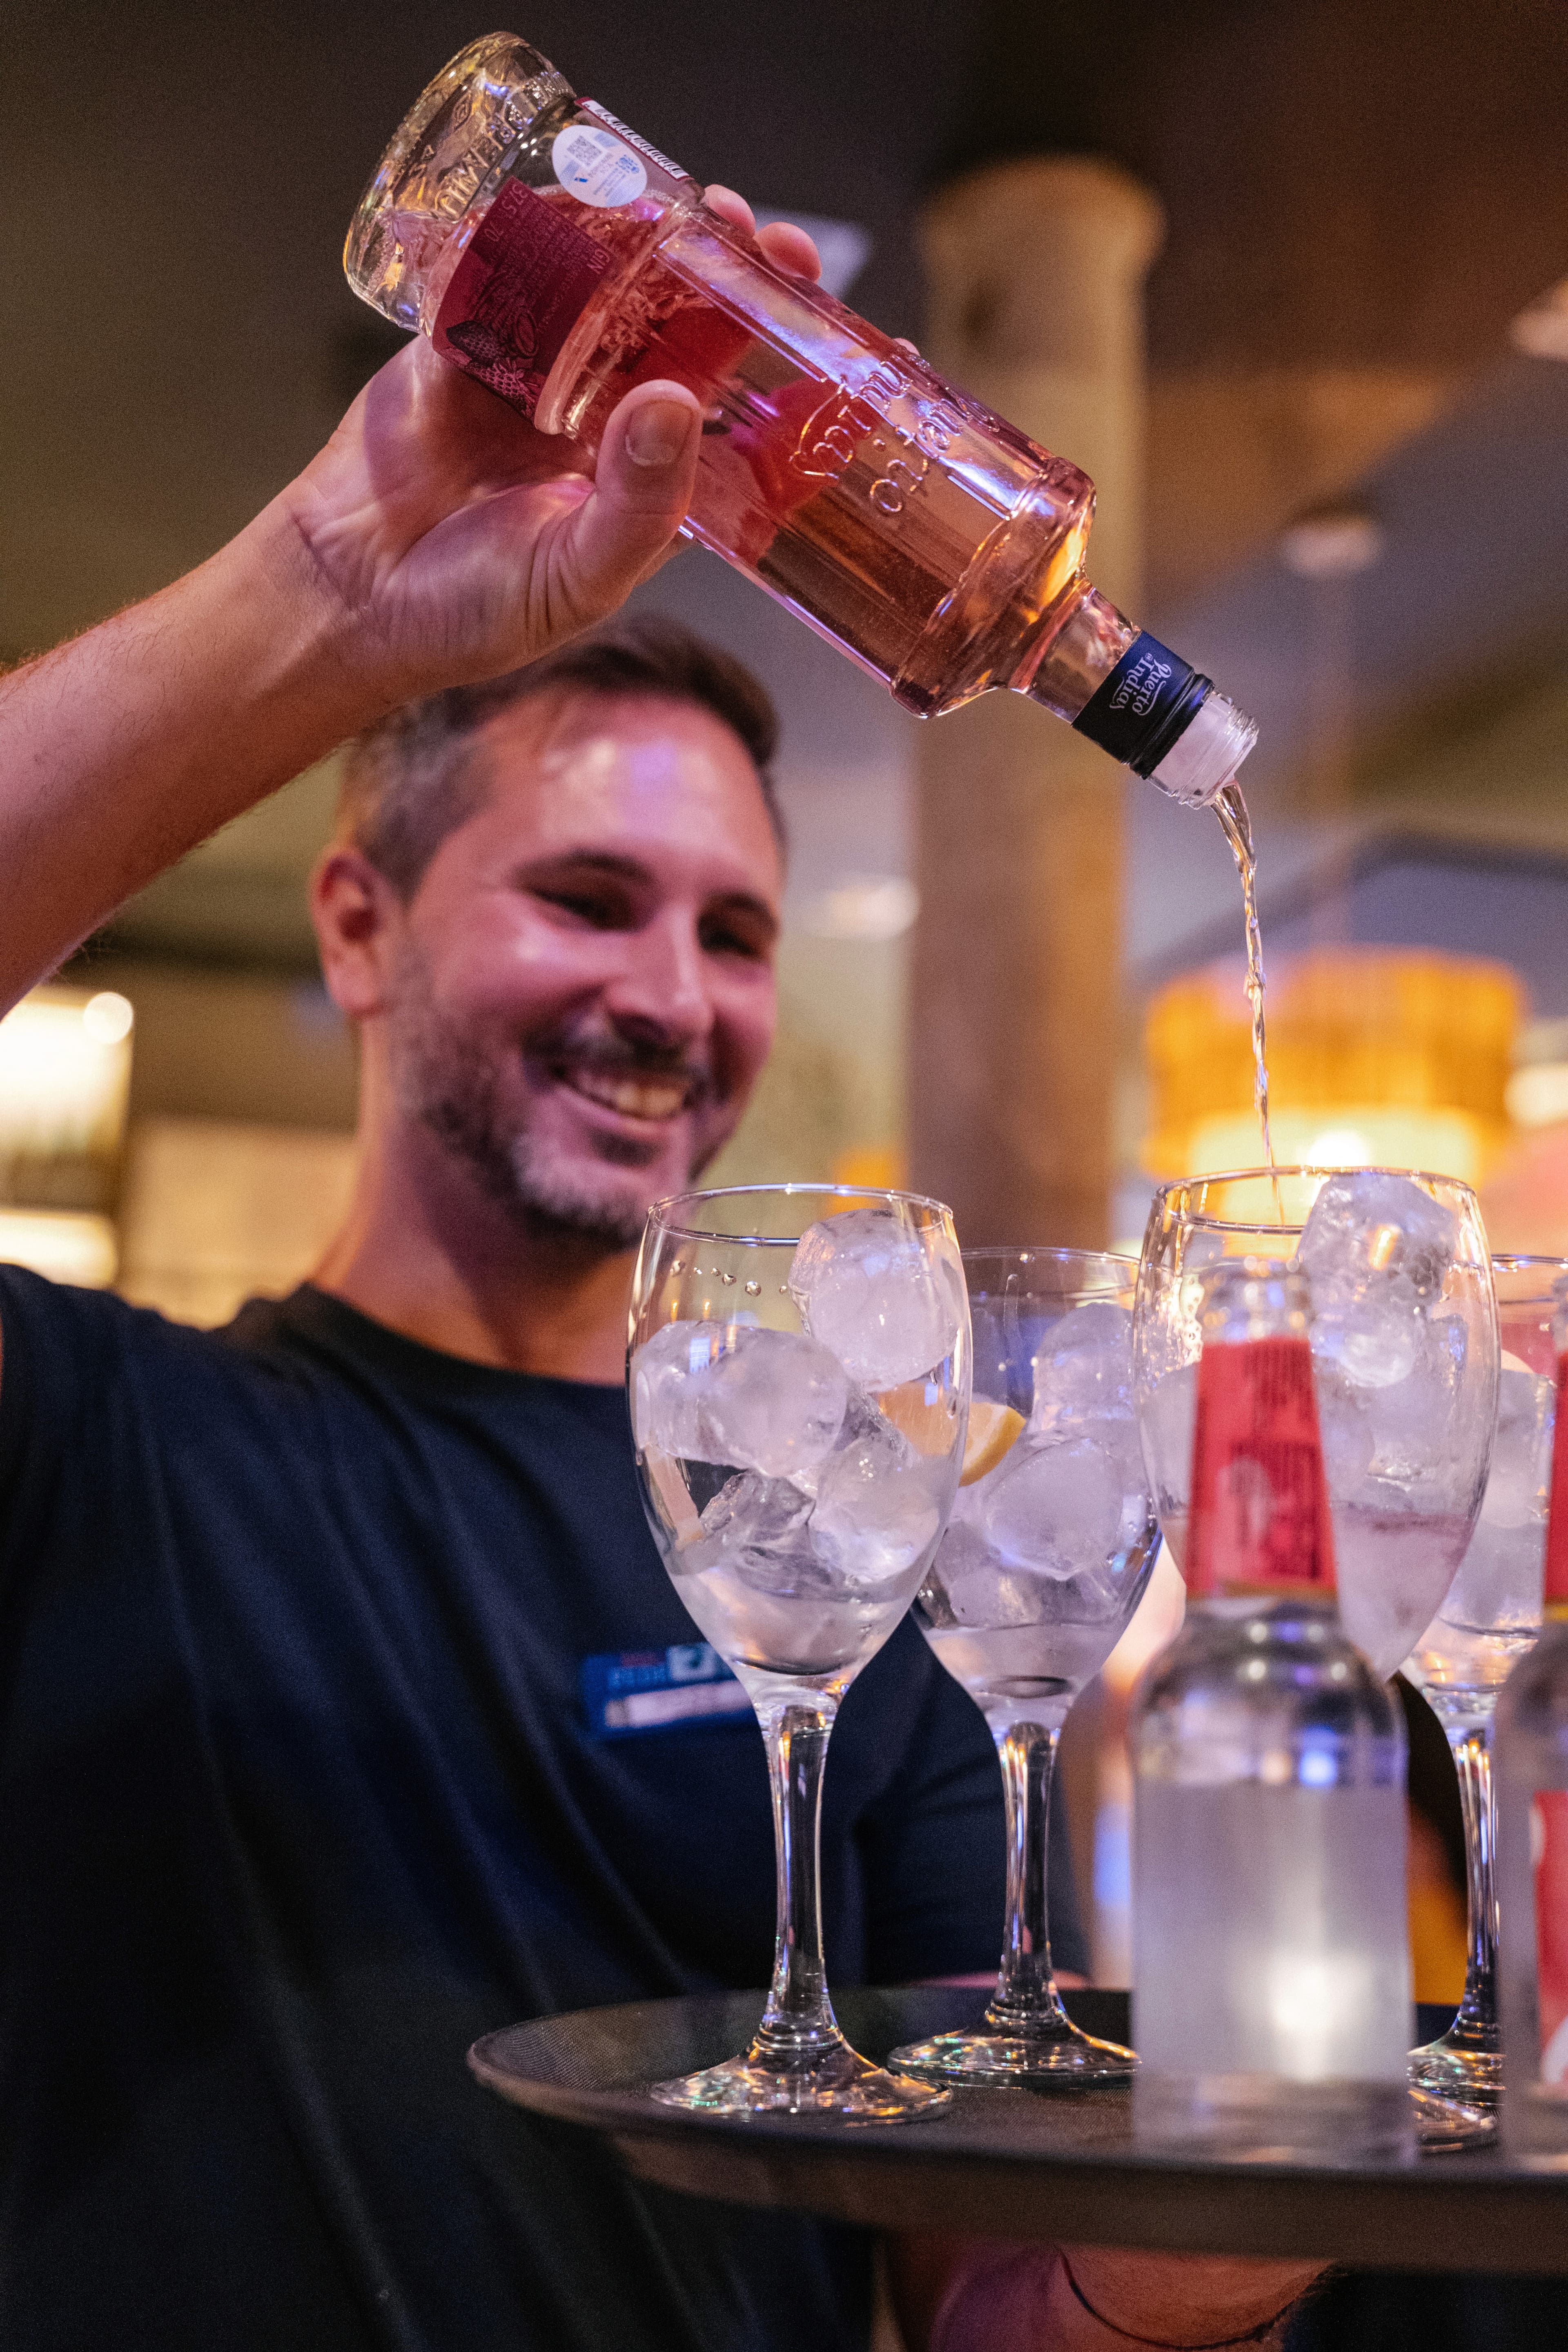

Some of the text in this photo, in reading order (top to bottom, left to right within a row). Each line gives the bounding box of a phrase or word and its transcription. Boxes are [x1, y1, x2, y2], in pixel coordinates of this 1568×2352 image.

[585, 247, 612, 275] GIN
[1109, 657, 1154, 708] Indias
[1131, 659, 1171, 715] Puerto
